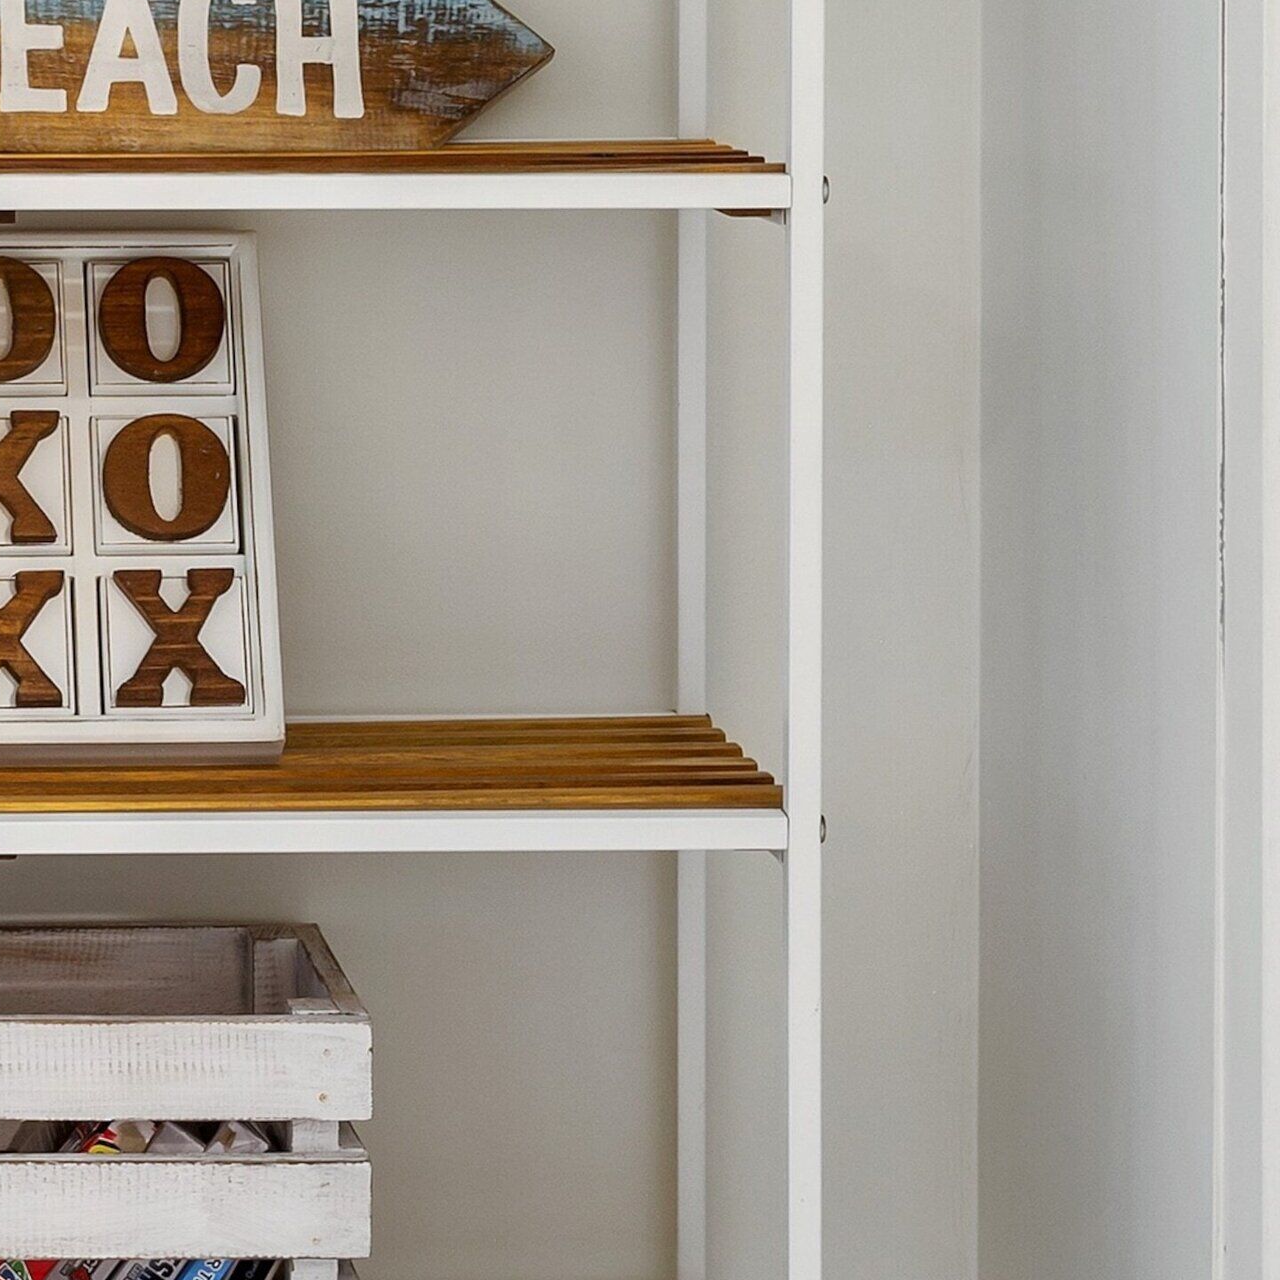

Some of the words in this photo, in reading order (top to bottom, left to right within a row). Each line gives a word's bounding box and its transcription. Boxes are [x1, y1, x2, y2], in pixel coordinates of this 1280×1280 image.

[98, 256, 225, 383] O
[103, 413, 231, 542] O
[114, 568, 246, 707] X
